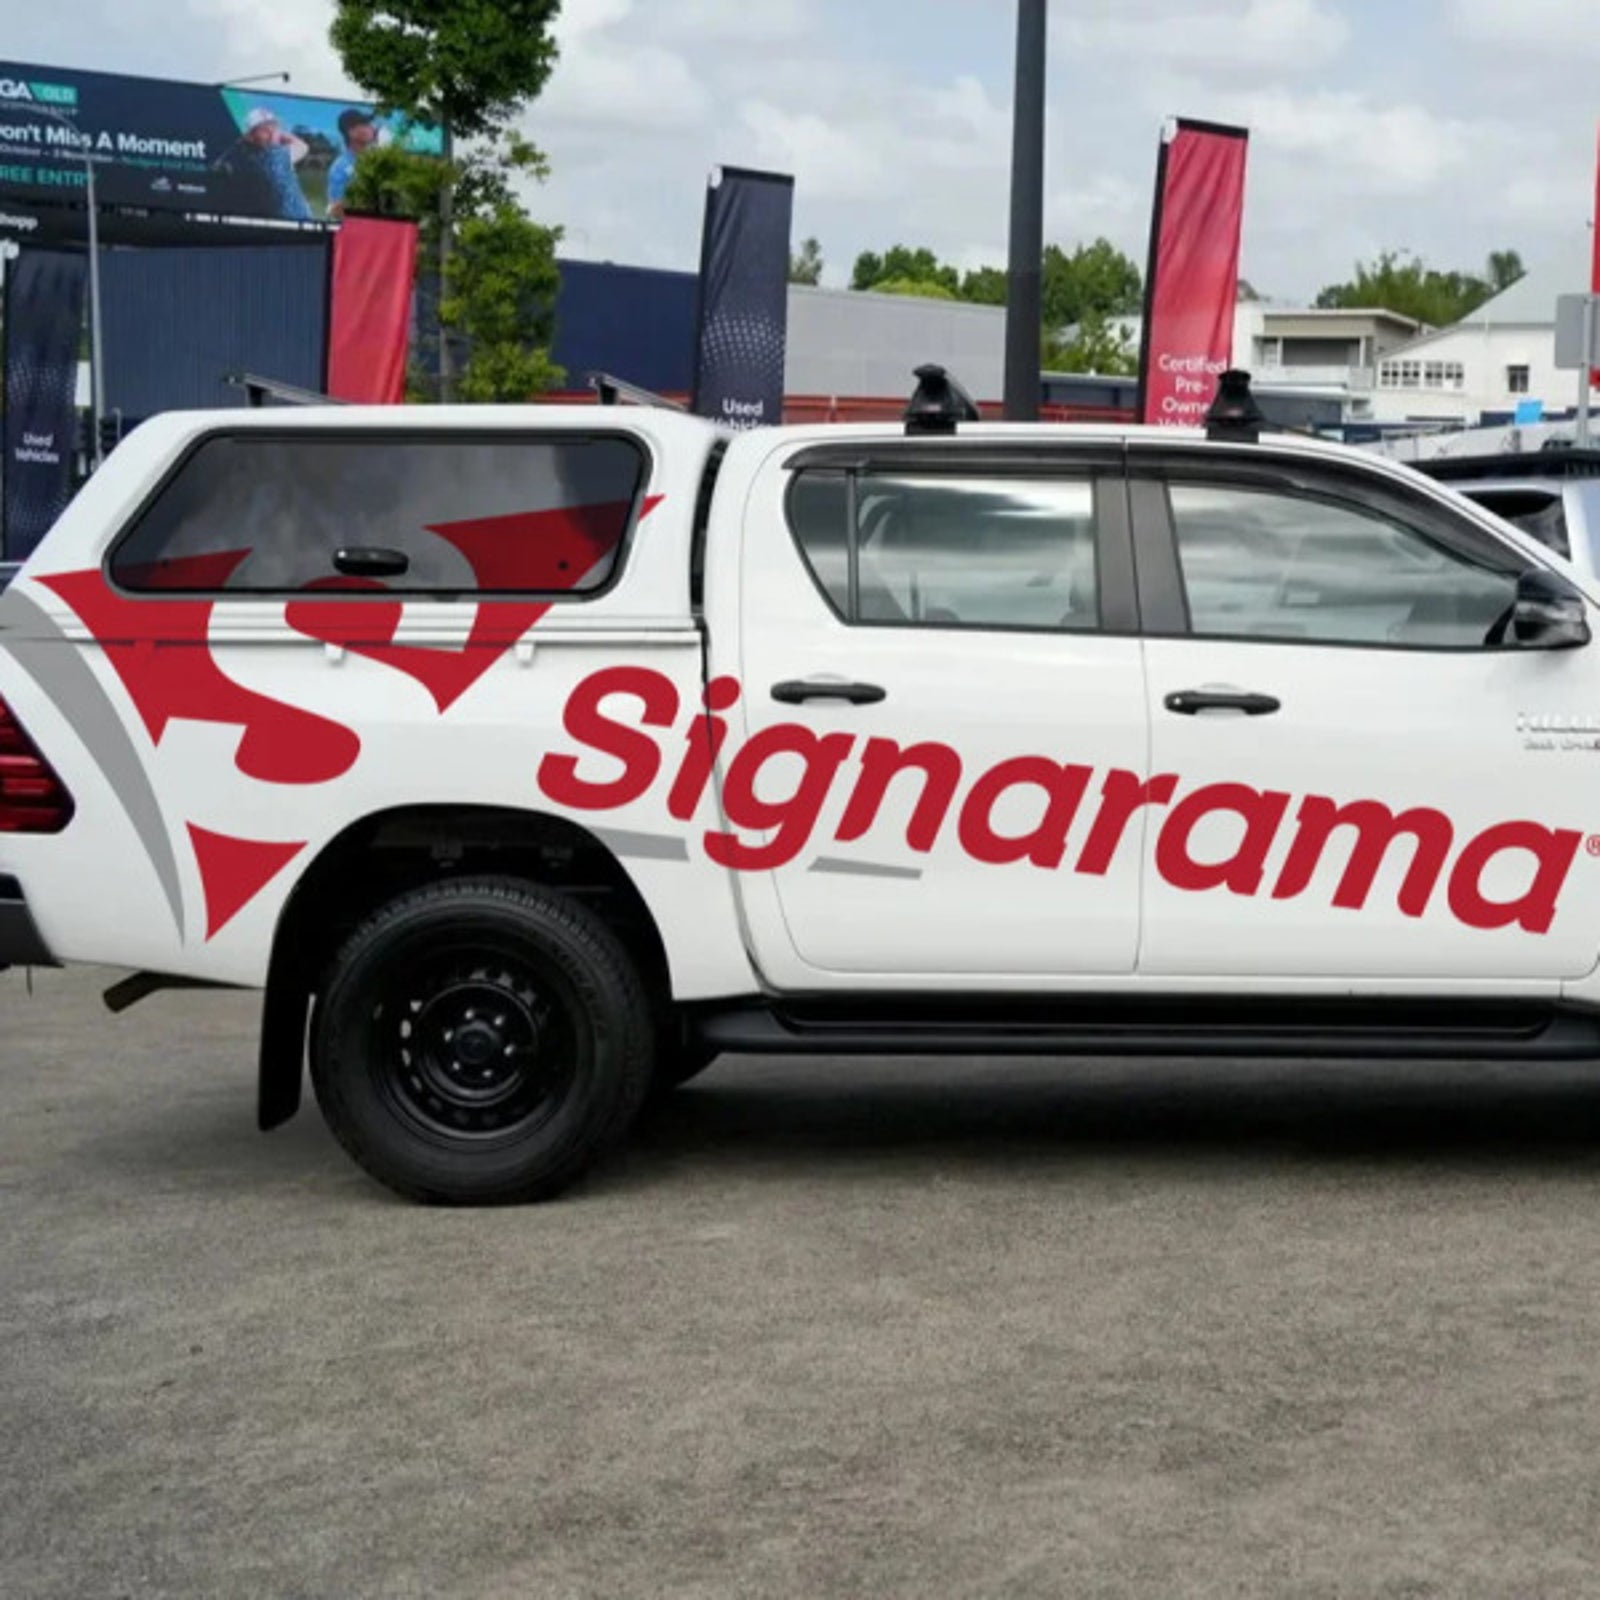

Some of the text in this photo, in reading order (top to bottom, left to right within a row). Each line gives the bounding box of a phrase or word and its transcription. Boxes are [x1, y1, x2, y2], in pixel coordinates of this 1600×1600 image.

[46, 125, 92, 148] Miss
[96, 131, 114, 150] A
[117, 132, 207, 159] Moment
[1158, 353, 1228, 374] Certified
[1175, 375, 1209, 393] Pre-
[722, 398, 764, 417] Used
[1161, 396, 1211, 414] Owne
[23, 432, 54, 447] Used
[14, 447, 60, 463] Vehicles
[538, 666, 1583, 934] Signarama
